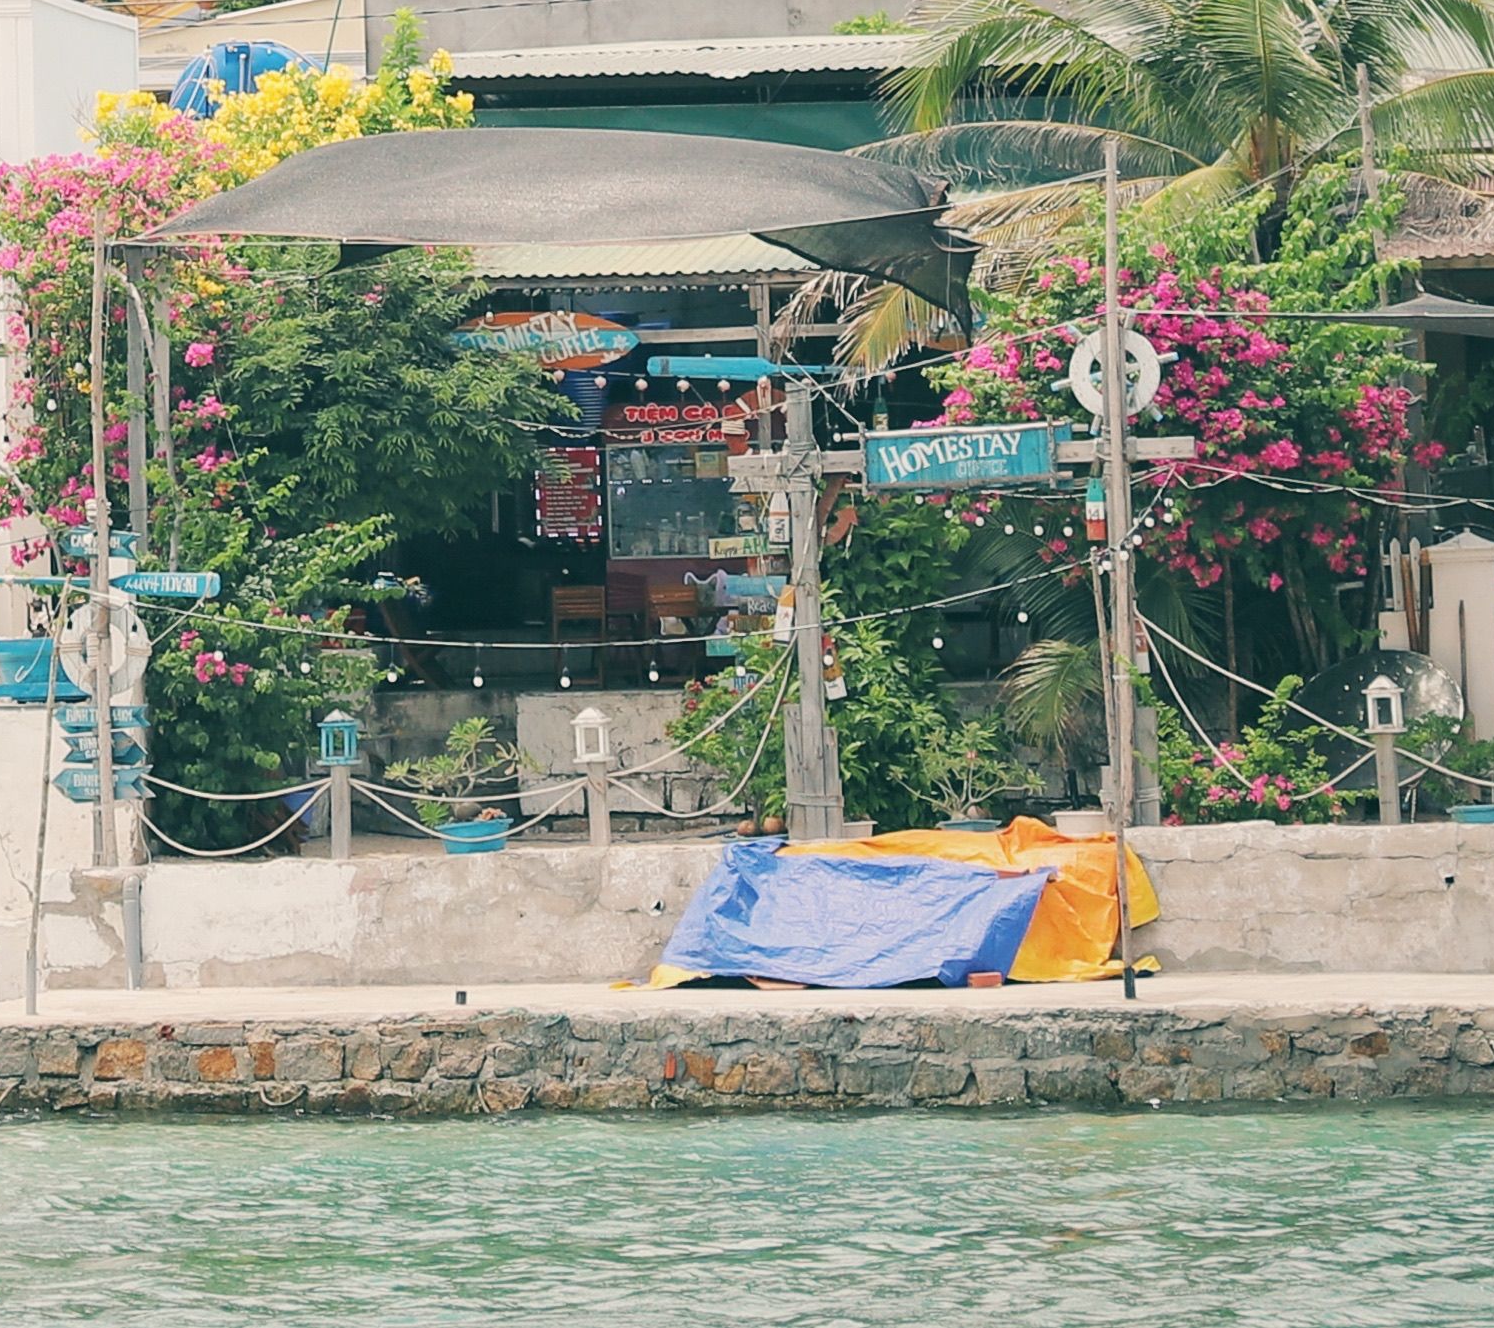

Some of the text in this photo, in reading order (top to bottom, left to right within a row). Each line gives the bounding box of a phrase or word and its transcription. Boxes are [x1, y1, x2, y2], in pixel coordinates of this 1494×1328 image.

[540, 328, 605, 364] COFFEE
[624, 403, 678, 425] TIỆM
[682, 401, 719, 422] CÀ
[878, 431, 1023, 484] HOMESTAY
[124, 576, 197, 594] BEACH HAPPY
